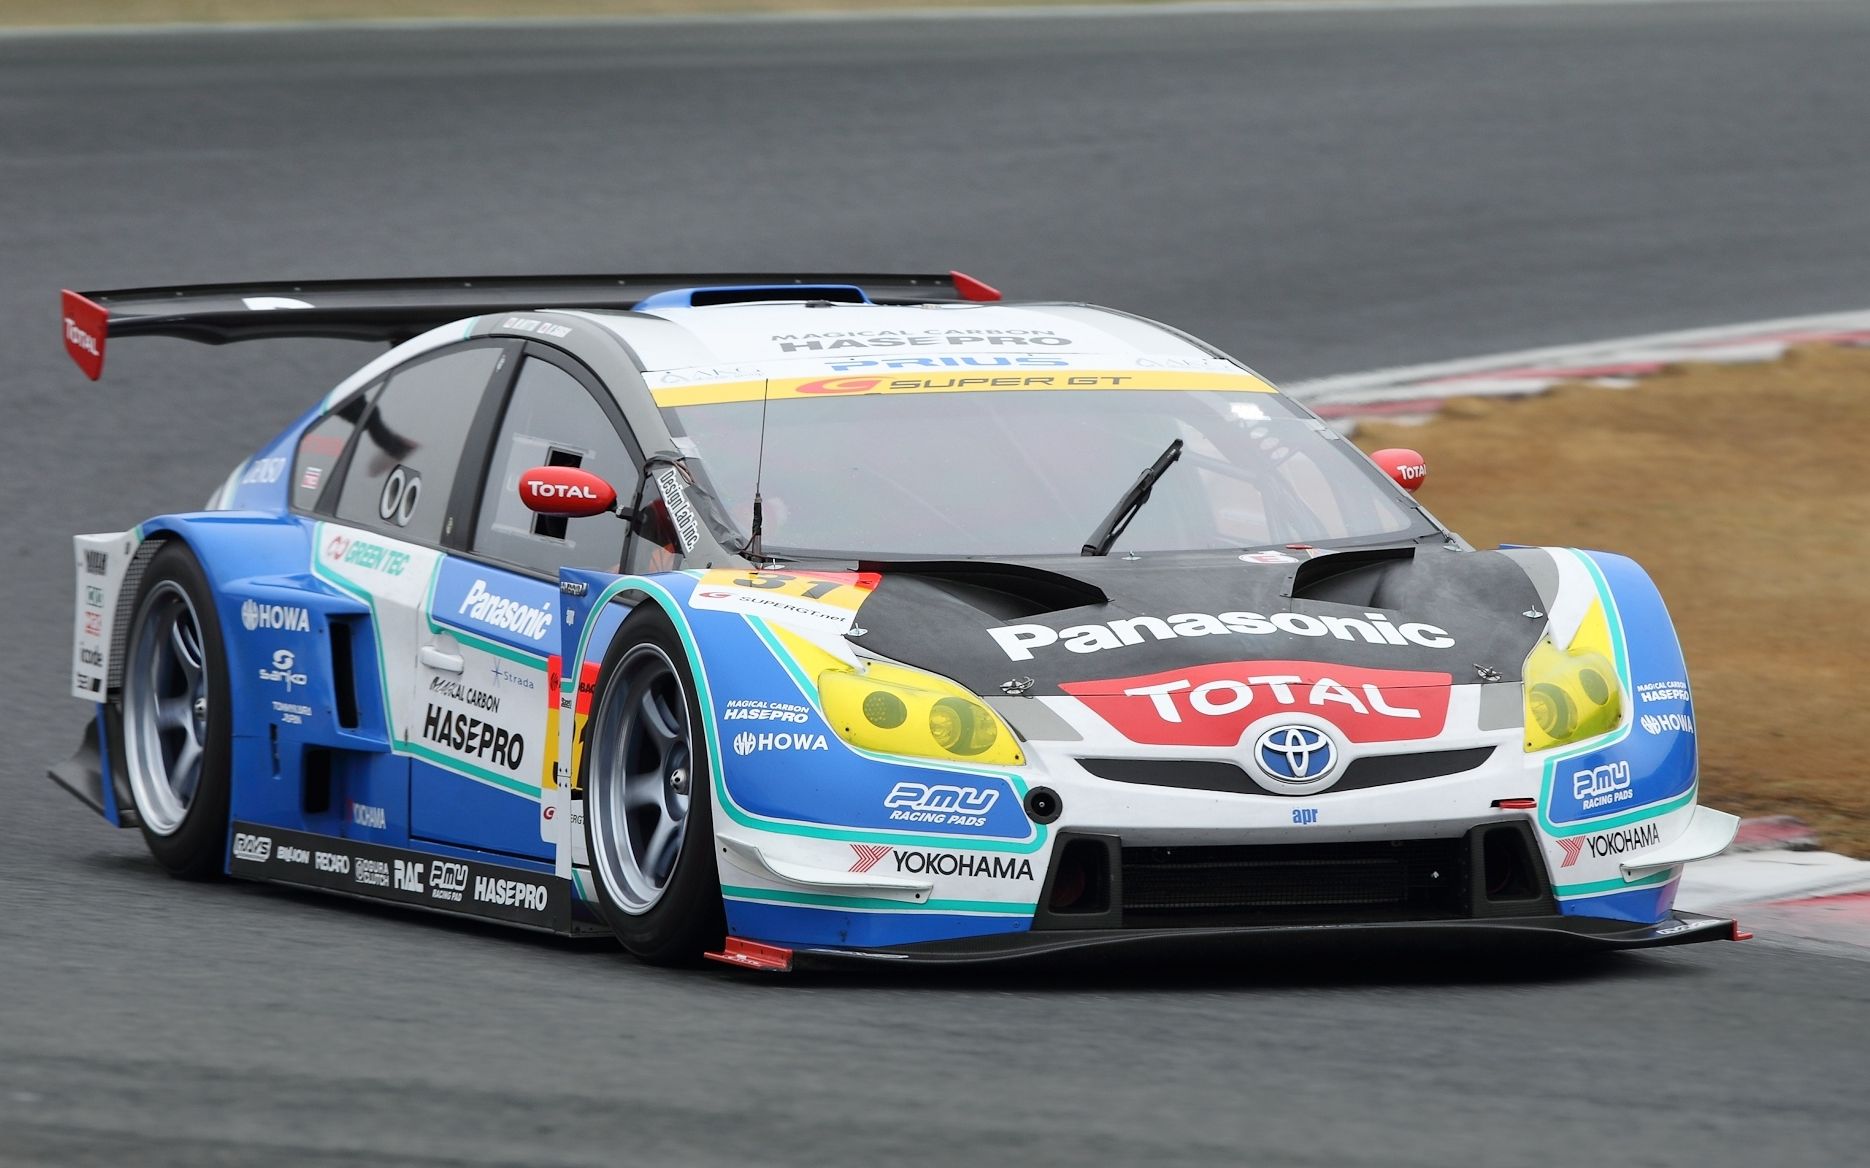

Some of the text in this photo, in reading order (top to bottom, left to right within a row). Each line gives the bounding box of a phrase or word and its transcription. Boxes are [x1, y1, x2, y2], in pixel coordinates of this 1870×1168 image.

[64, 317, 100, 356] TOTAL
[772, 328, 1056, 341] MAGICAL CARBON
[779, 336, 1072, 353] HASEPRO
[824, 357, 1069, 372] PRIUS
[889, 375, 1132, 390] SUPER GT
[527, 479, 597, 500] TOTAL
[659, 468, 700, 551] Design Lab inc.
[344, 540, 410, 576] GREEN TEC
[733, 572, 842, 599] 31
[259, 604, 310, 632] HOWA
[459, 579, 552, 640] Panasonic
[739, 596, 846, 623] SUPERGT.net
[986, 611, 1455, 662] Panasonic
[504, 671, 534, 689] Strada
[466, 688, 500, 713] CARBON
[727, 700, 809, 713] MAGICAL CARBON
[1124, 675, 1421, 724] TOTAL
[723, 708, 809, 724] HASEPRO
[1657, 714, 1694, 734] HOWA
[423, 703, 524, 770] HASEPRO
[758, 733, 829, 751] HOWA
[1583, 789, 1633, 810] RACING PADS
[890, 810, 986, 827] RACING PADS
[1292, 808, 1319, 825] apr
[1587, 823, 1660, 858] YOKOHAMA
[314, 851, 350, 874] RECARO
[893, 851, 1034, 880] YOKOHAMA
[432, 889, 452, 900] RACING
[474, 876, 548, 911] HASEPRO
